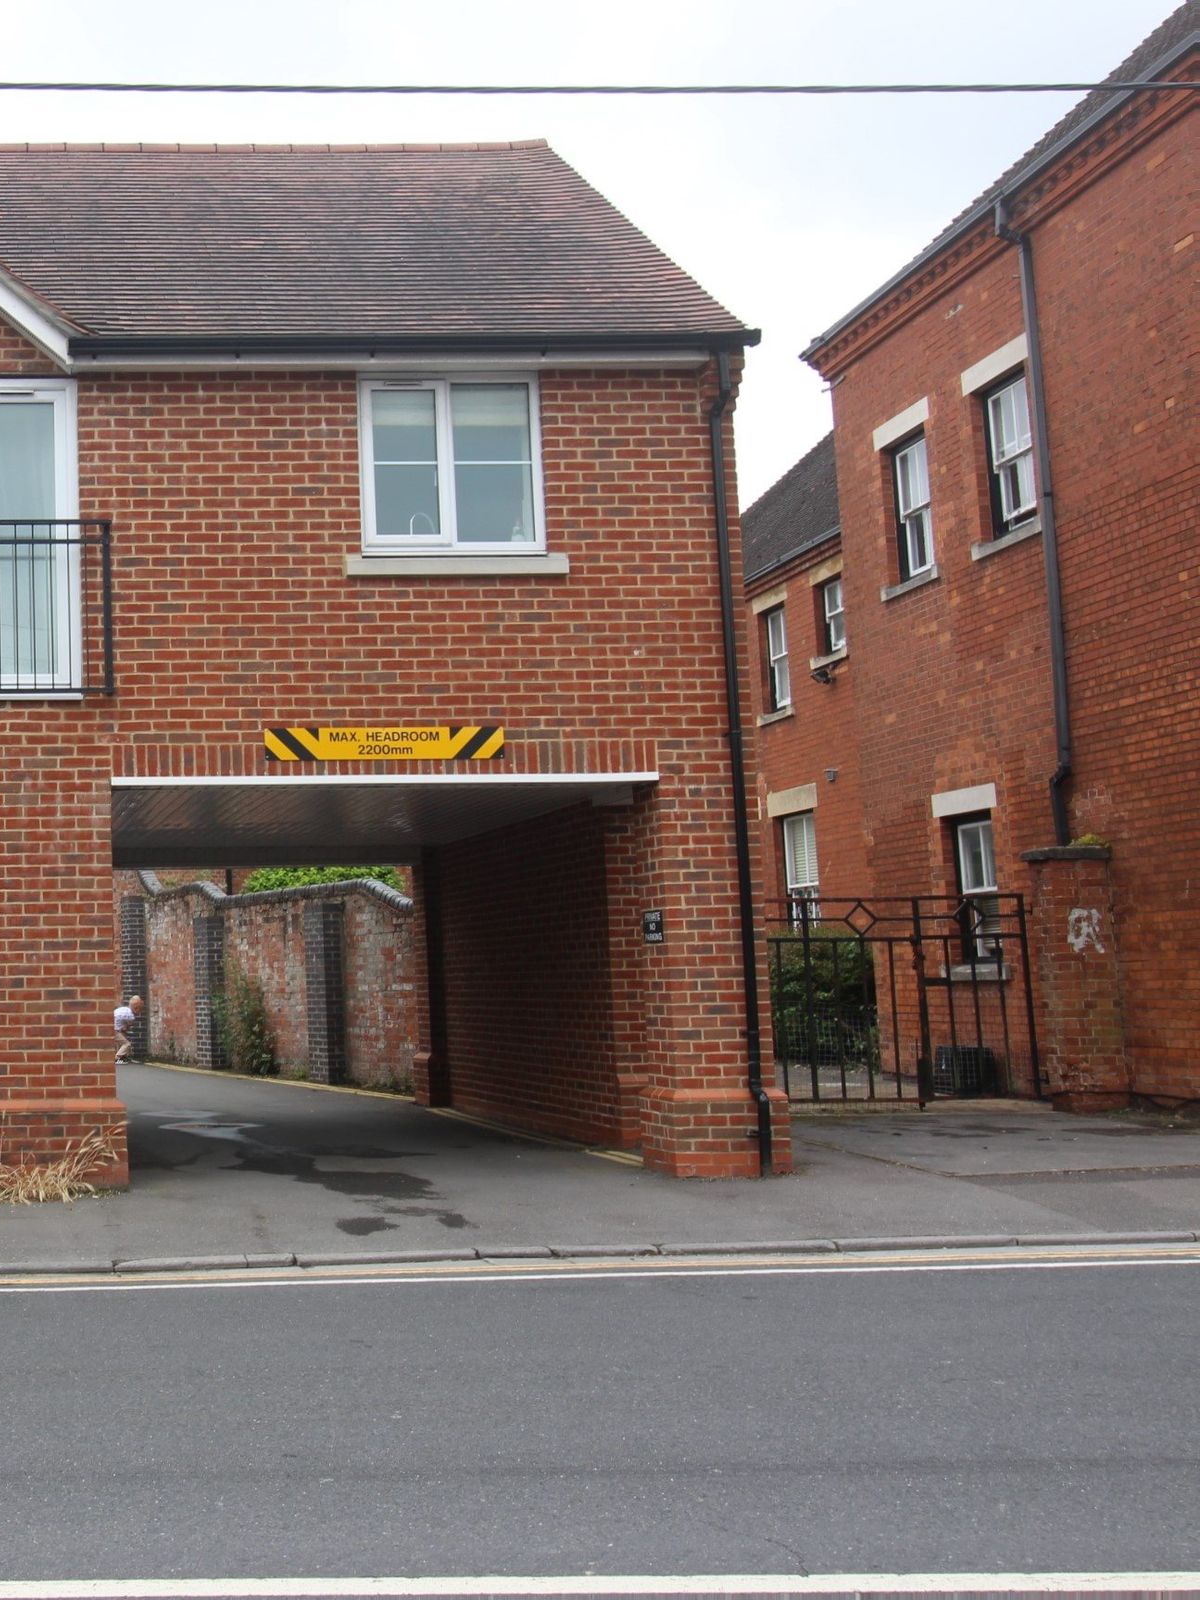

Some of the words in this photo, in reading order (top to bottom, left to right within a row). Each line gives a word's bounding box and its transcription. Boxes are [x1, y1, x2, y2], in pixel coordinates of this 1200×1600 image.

[329, 731, 361, 743] MAX.
[366, 731, 440, 742] HEADROOM
[358, 744, 413, 755] 2200mm
[649, 922, 656, 931] NO
[644, 932, 663, 941] PARKING
